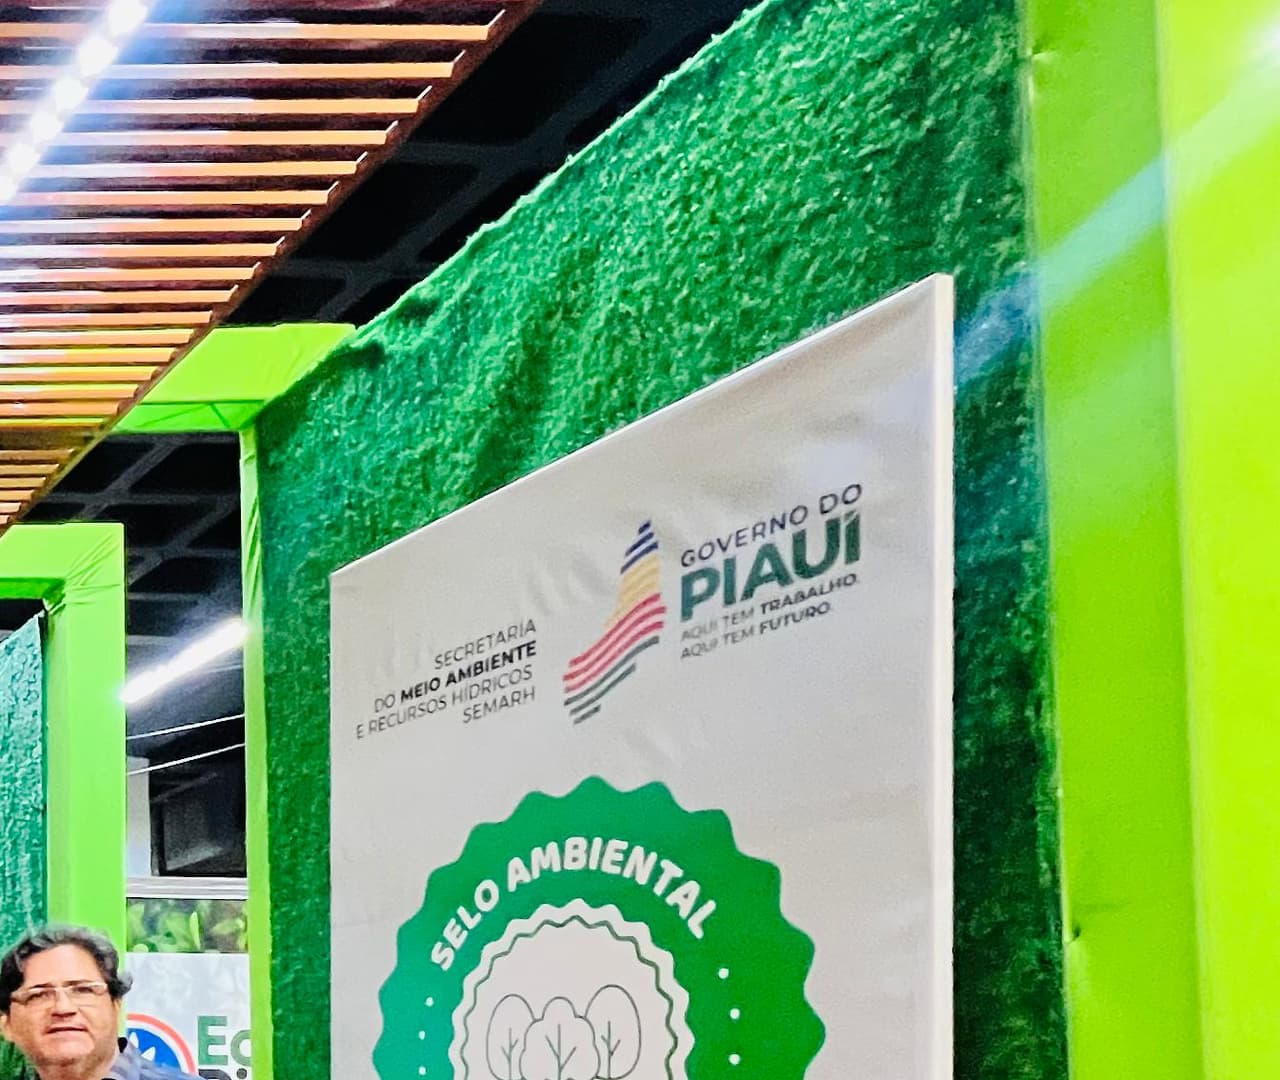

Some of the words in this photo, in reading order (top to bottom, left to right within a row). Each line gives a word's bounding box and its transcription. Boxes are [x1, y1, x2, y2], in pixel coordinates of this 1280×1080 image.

[680, 505, 809, 568] GOVERNO
[819, 483, 862, 515] DO
[680, 510, 861, 622] PIAUÍ
[434, 618, 537, 670] SECRETARIA
[680, 636, 718, 660] AQUI
[723, 624, 755, 645] TEM
[681, 618, 718, 642] AQUI
[722, 607, 755, 626] TEM
[356, 724, 364, 740] E
[368, 695, 448, 735] RECURSOS
[451, 664, 533, 706] HÍDRICOS
[374, 693, 396, 713] DO
[400, 677, 441, 704] MEIO
[444, 639, 537, 687] AMBIENTE
[462, 685, 536, 724] SEMARH
[430, 879, 499, 971] SELO
[506, 836, 717, 940] AMBIENTAL
[197, 1015, 251, 1066] Ec
